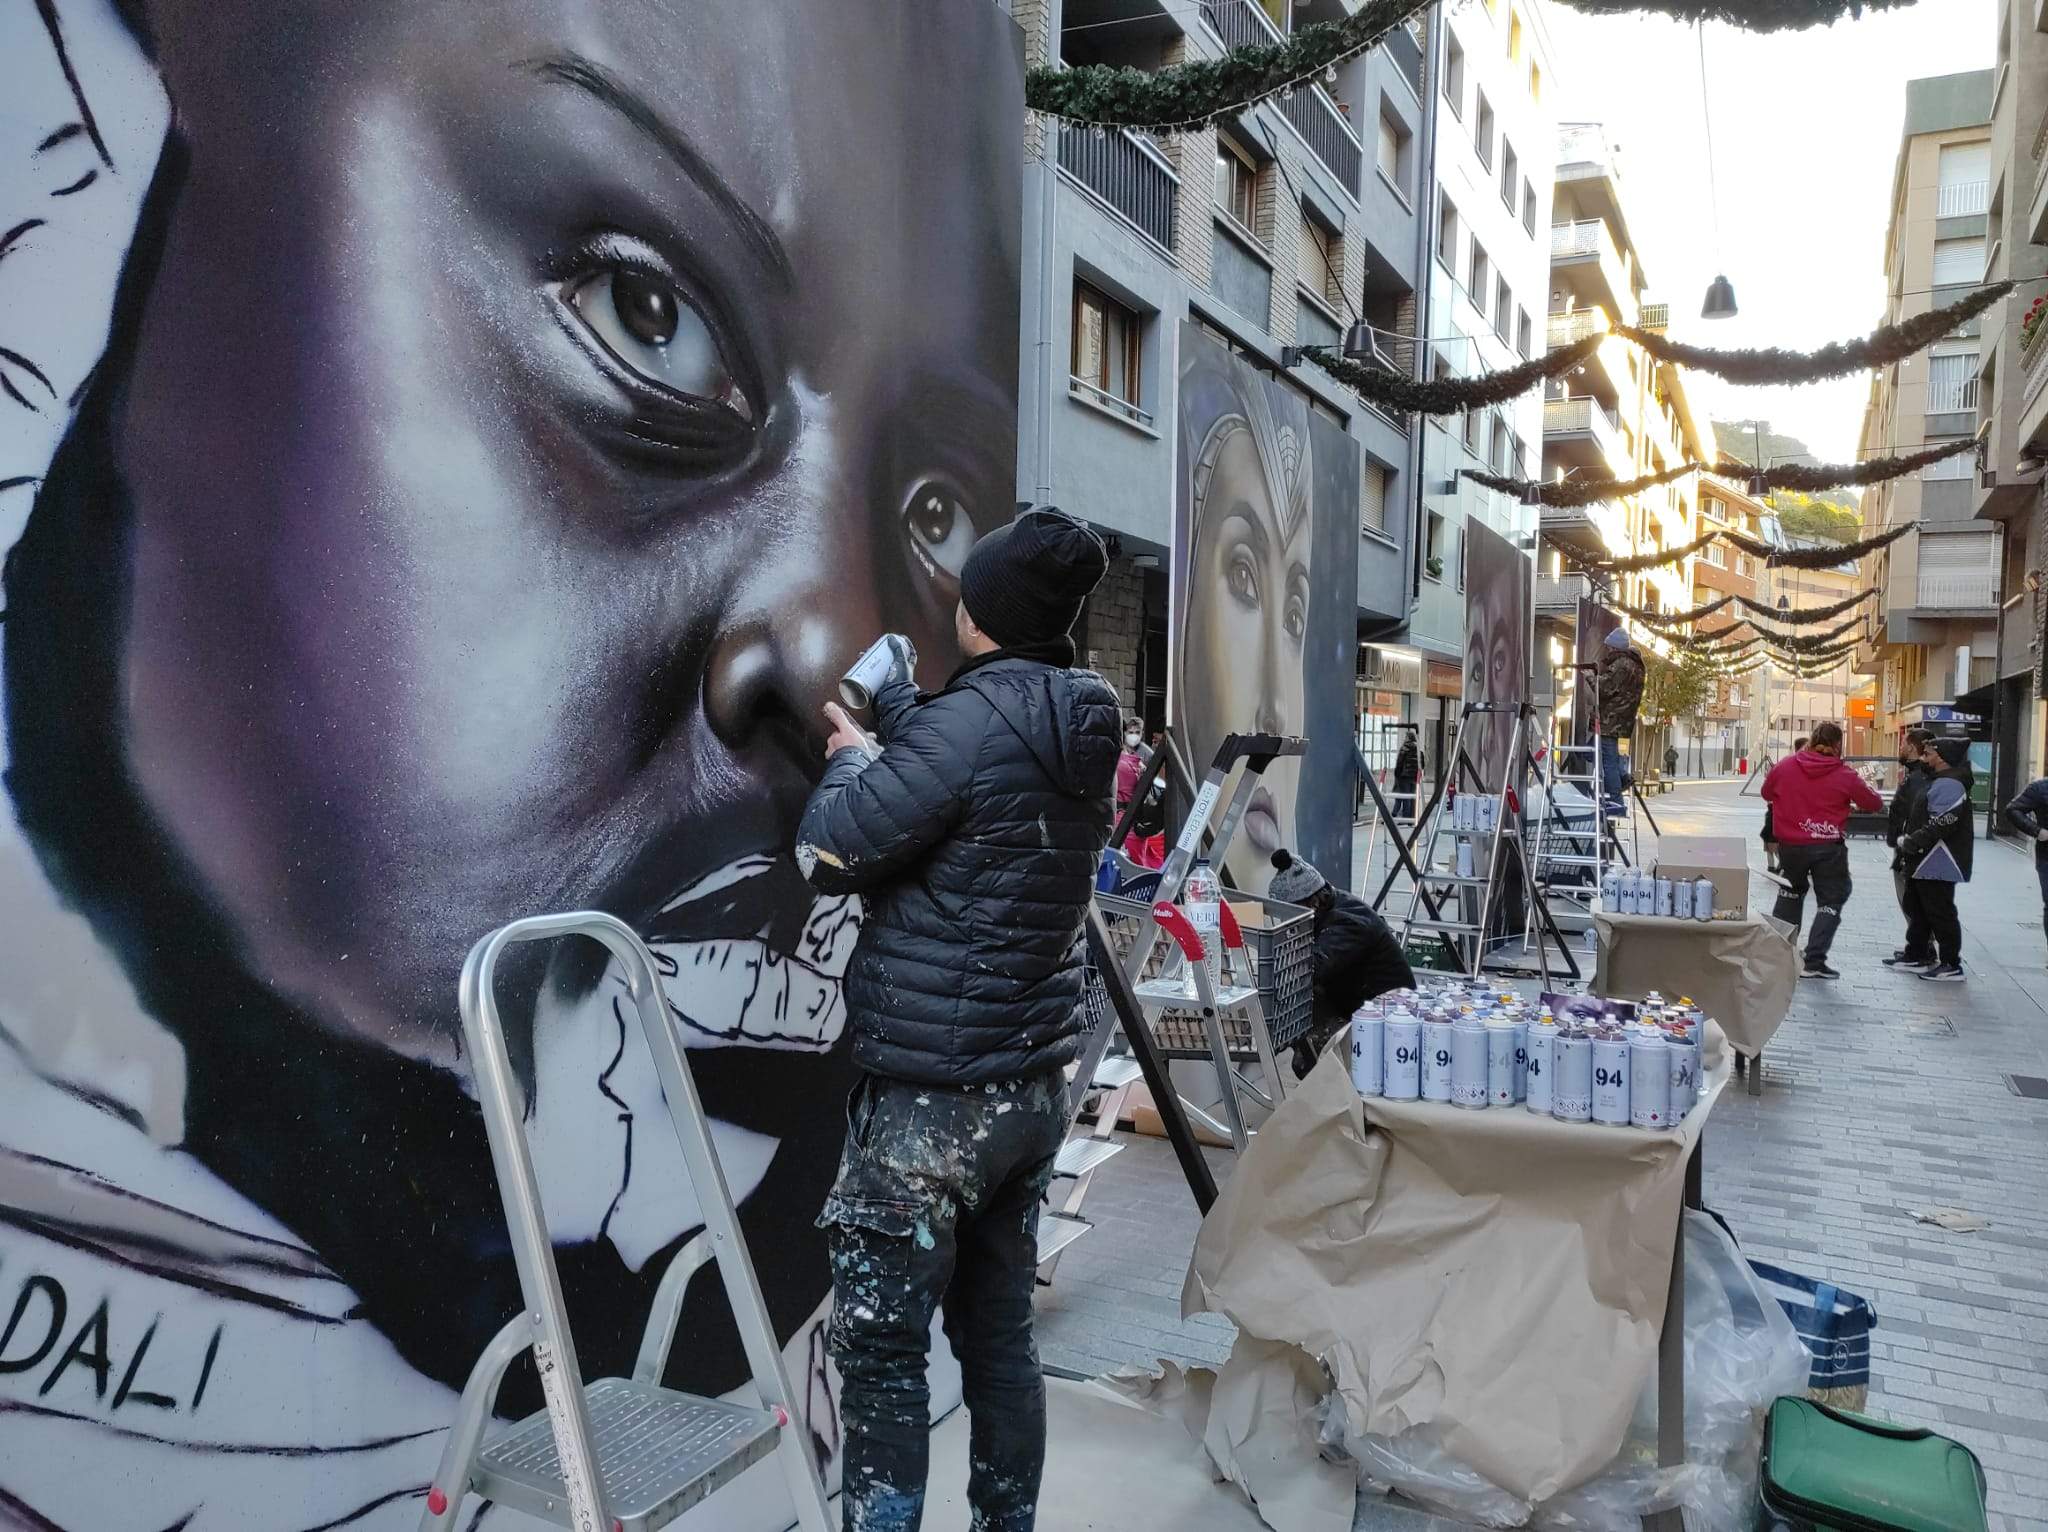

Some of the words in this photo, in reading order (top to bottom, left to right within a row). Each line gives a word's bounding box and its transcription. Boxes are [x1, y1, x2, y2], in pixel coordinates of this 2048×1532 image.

[1396, 1047, 1418, 1064] 94
[1435, 1049, 1453, 1067] 9
[1595, 1067, 1623, 1088] 94
[0, 1274, 225, 1415] DALI
